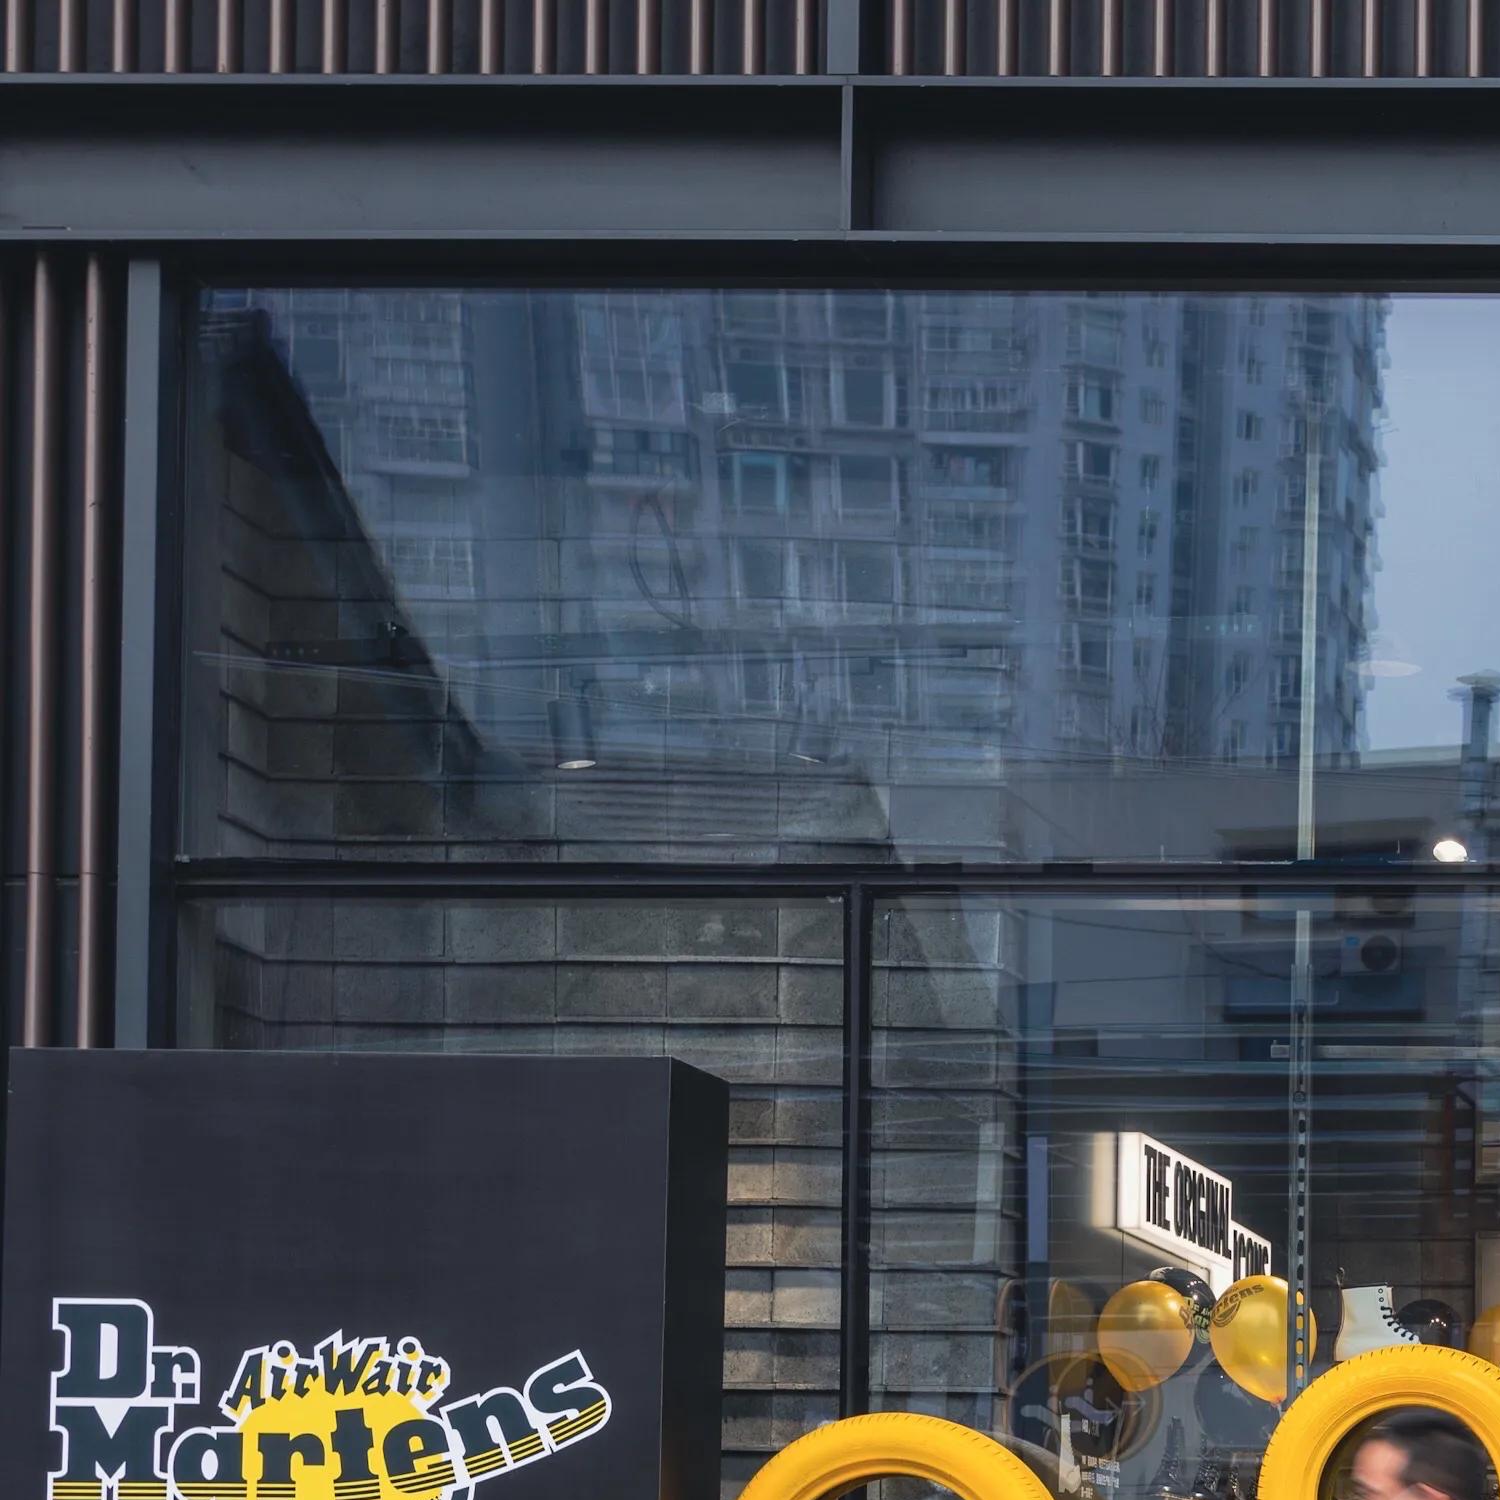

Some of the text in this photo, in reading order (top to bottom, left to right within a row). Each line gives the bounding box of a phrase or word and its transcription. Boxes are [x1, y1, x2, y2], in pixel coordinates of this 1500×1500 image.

[1144, 1144, 1232, 1260] THE ORIGINAL
[53, 1297, 201, 1405] Dr.
[219, 1330, 451, 1419] AirWair
